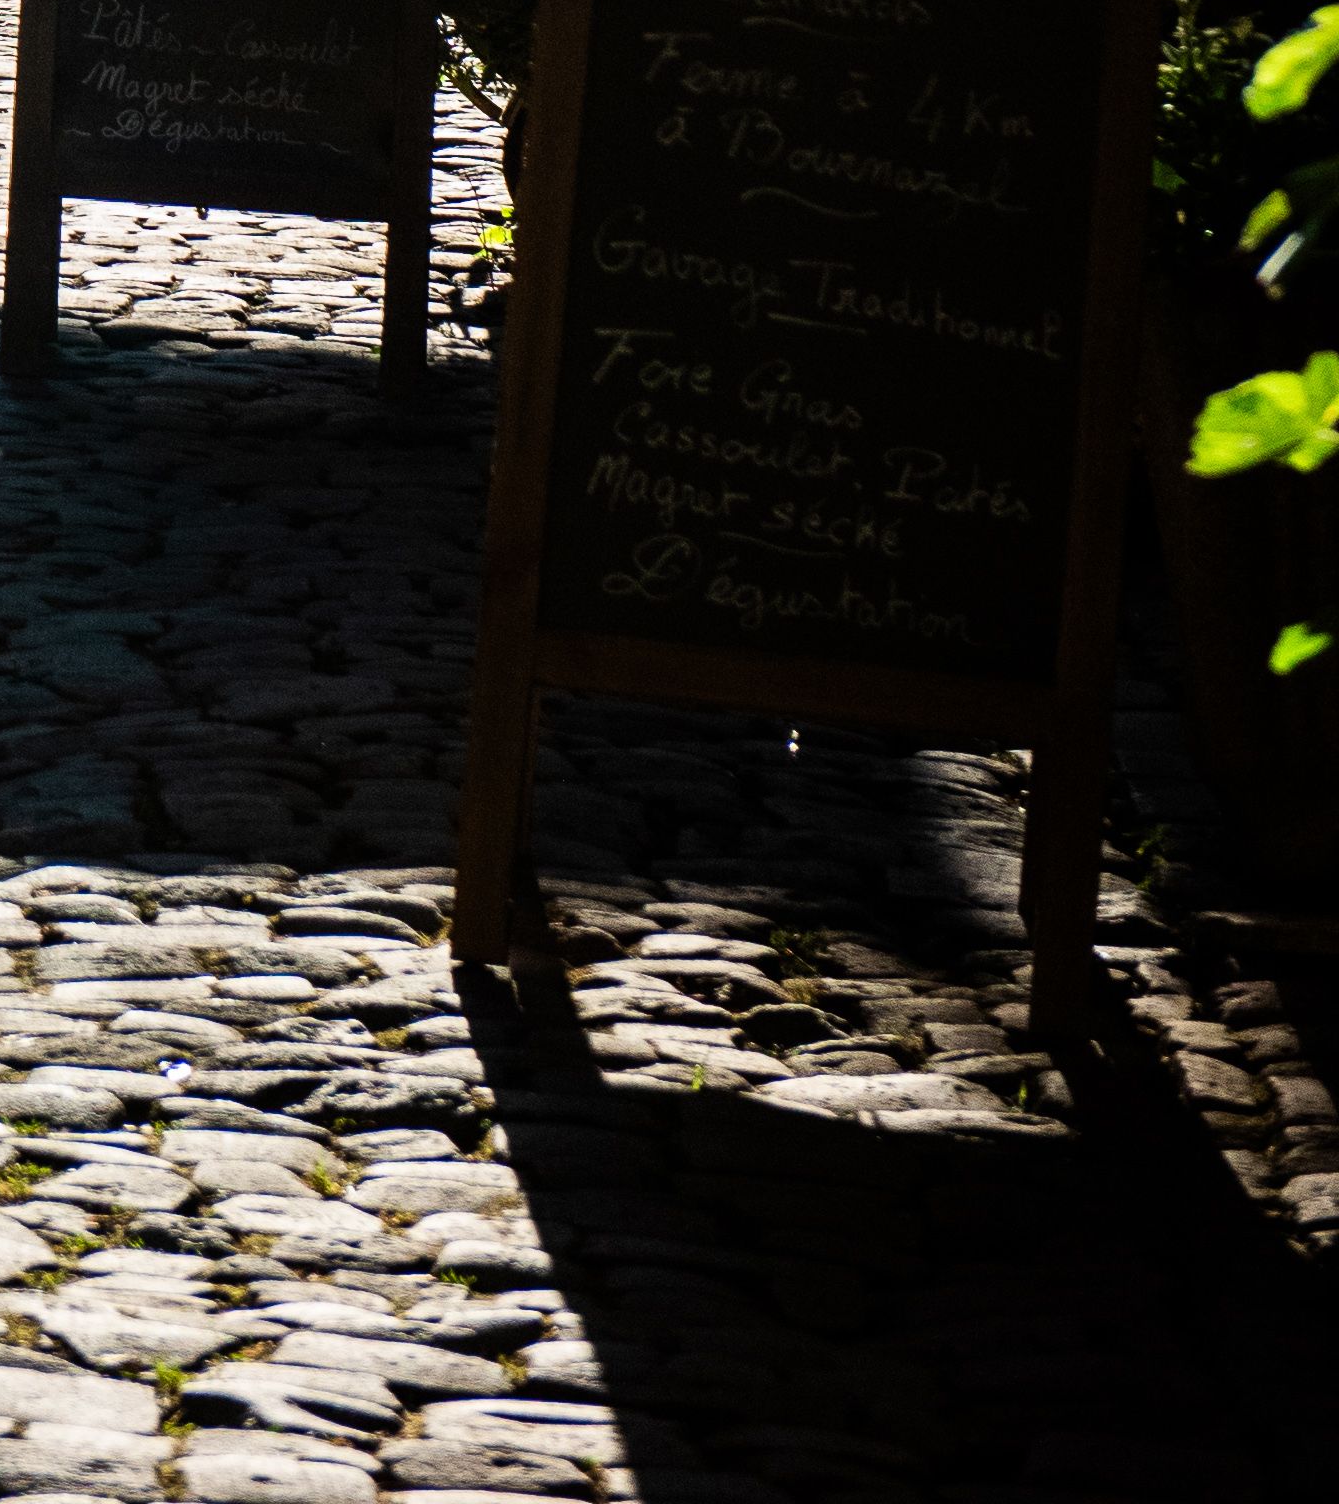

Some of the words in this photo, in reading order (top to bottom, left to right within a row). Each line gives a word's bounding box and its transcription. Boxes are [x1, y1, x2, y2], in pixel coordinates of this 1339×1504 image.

[223, 16, 363, 66] Cassoulet
[80, 59, 211, 116] Magret
[640, 30, 802, 104] Ferme
[906, 73, 947, 144] 4
[100, 107, 306, 155] Dégustation
[718, 106, 1030, 222] Bournazel
[592, 203, 787, 331] Gavage
[787, 257, 1064, 362] Traditionnel
[737, 357, 865, 431] Gras
[584, 450, 753, 529] Magret
[599, 530, 983, 644] Dégustation
